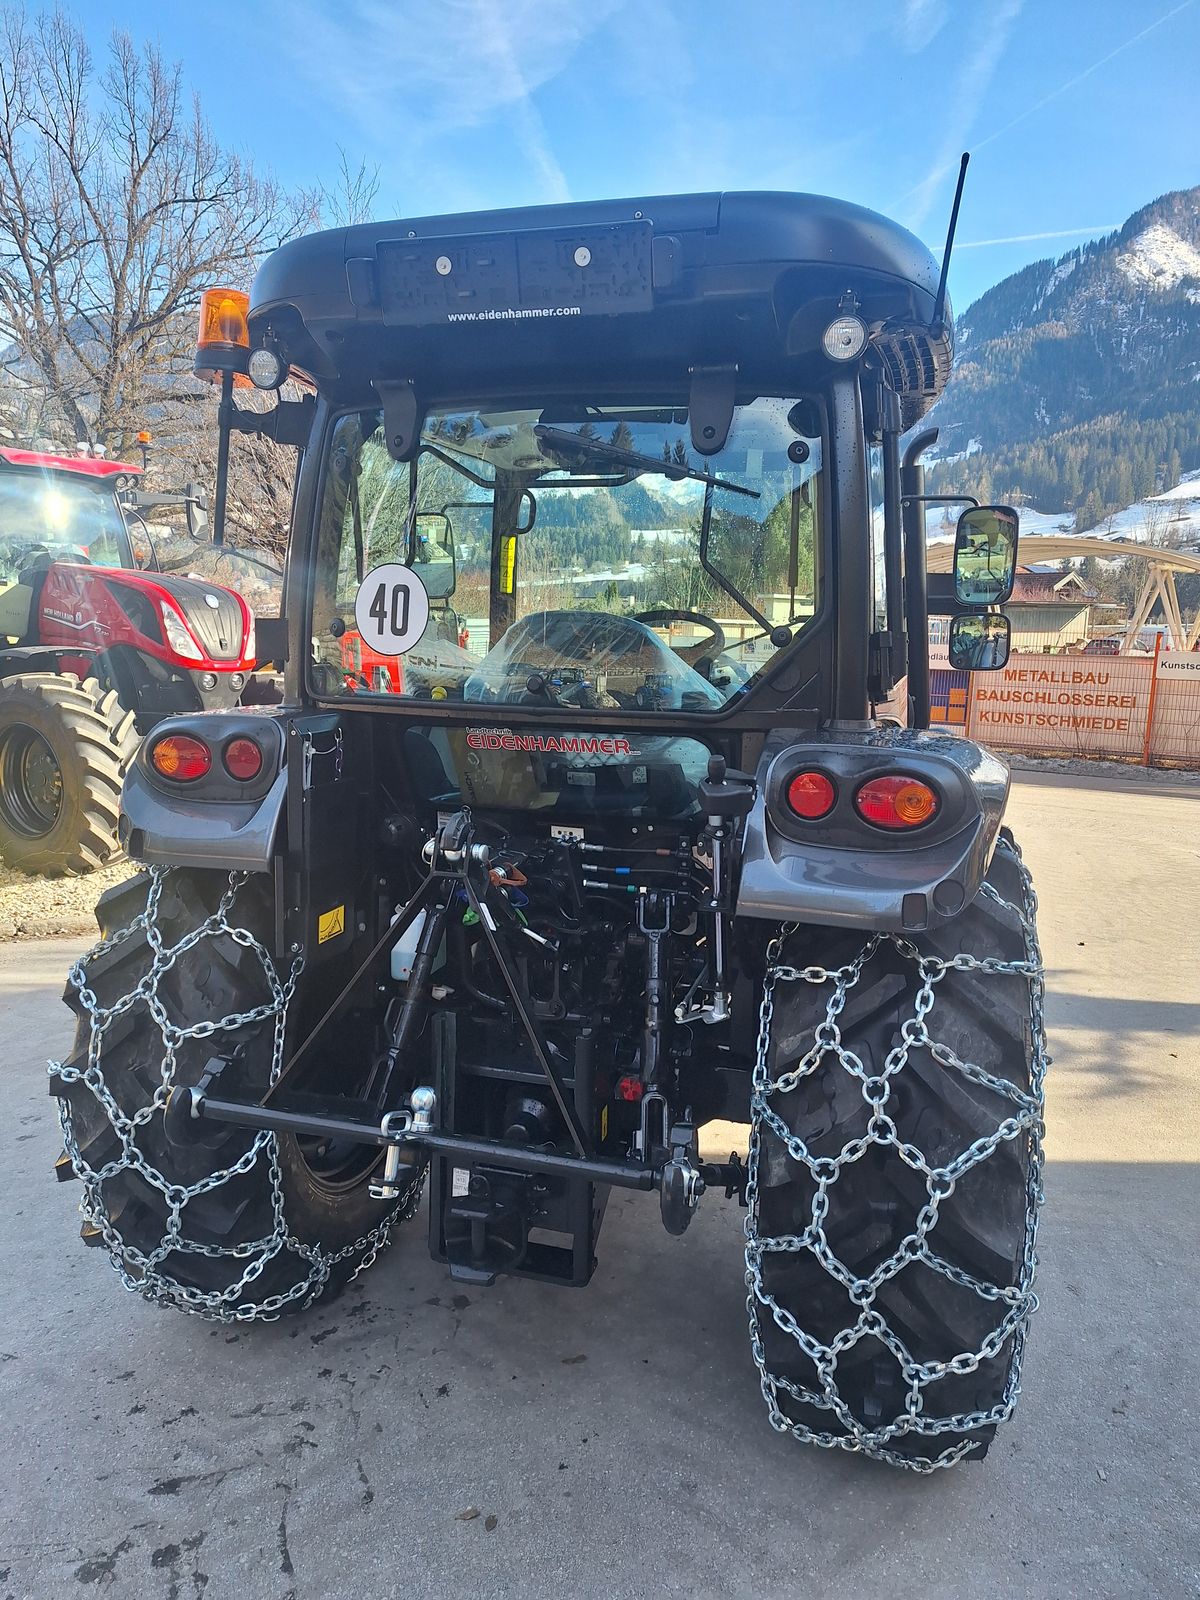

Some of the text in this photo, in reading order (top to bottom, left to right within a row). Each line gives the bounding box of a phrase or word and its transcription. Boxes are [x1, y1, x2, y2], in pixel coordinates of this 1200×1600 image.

[448, 306, 581, 322] www.eidenhammer.com
[369, 583, 410, 637] 40
[1003, 669, 1110, 685] METALLBAU
[976, 689, 1137, 709] BAUSCHLOSSEREI
[466, 727, 512, 735] Landtechnik
[979, 711, 1129, 731] KUNSTSCHMIEDE
[466, 734, 630, 755] EIDENHAMMER
